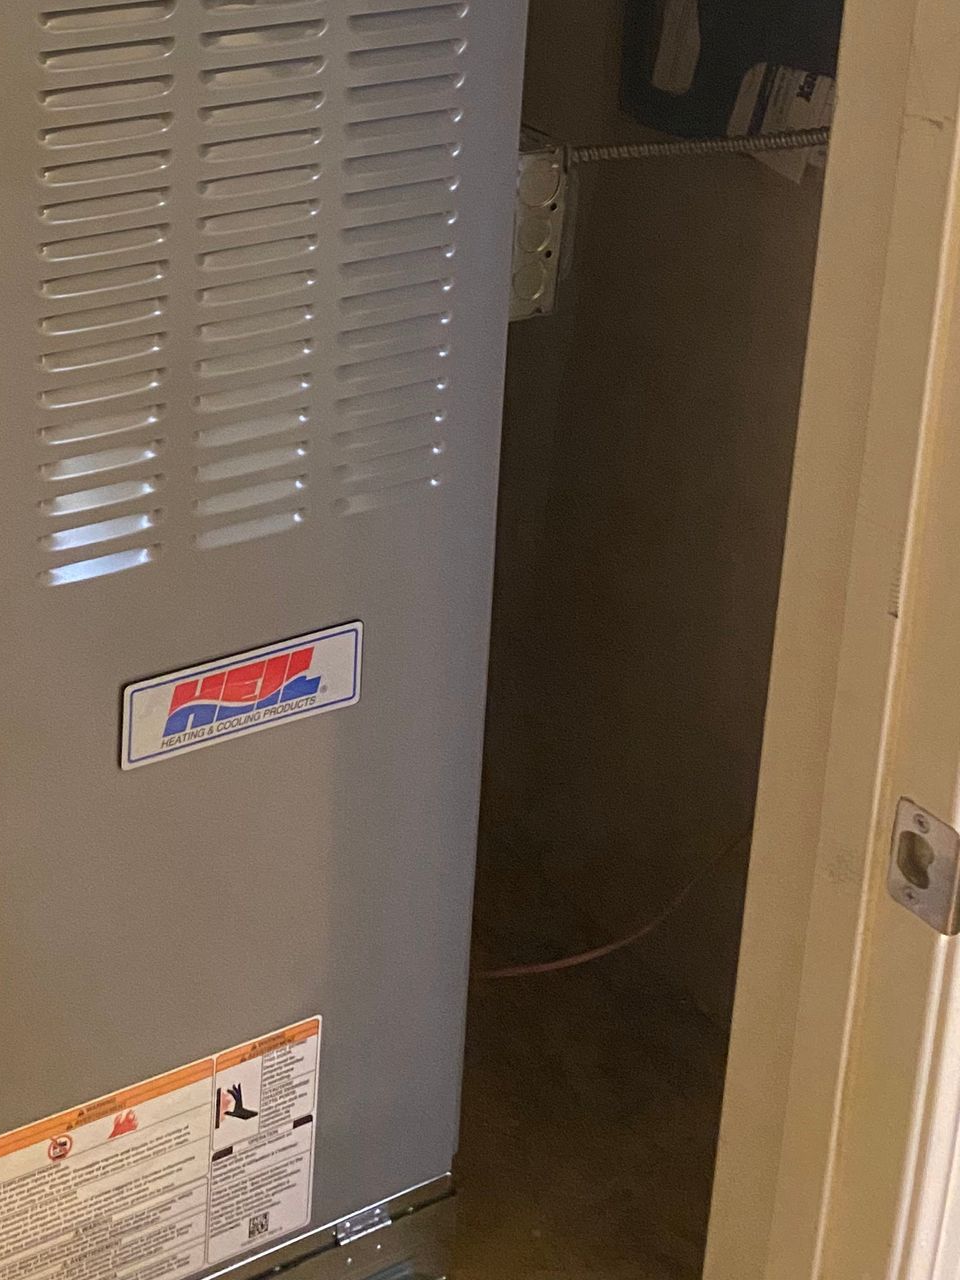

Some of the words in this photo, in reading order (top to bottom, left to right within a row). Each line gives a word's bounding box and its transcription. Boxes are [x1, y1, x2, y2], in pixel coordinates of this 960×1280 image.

[161, 727, 206, 750] HEATING
[207, 725, 215, 736] &
[216, 711, 262, 734] COOLING
[263, 695, 317, 719] PRODUCTS
